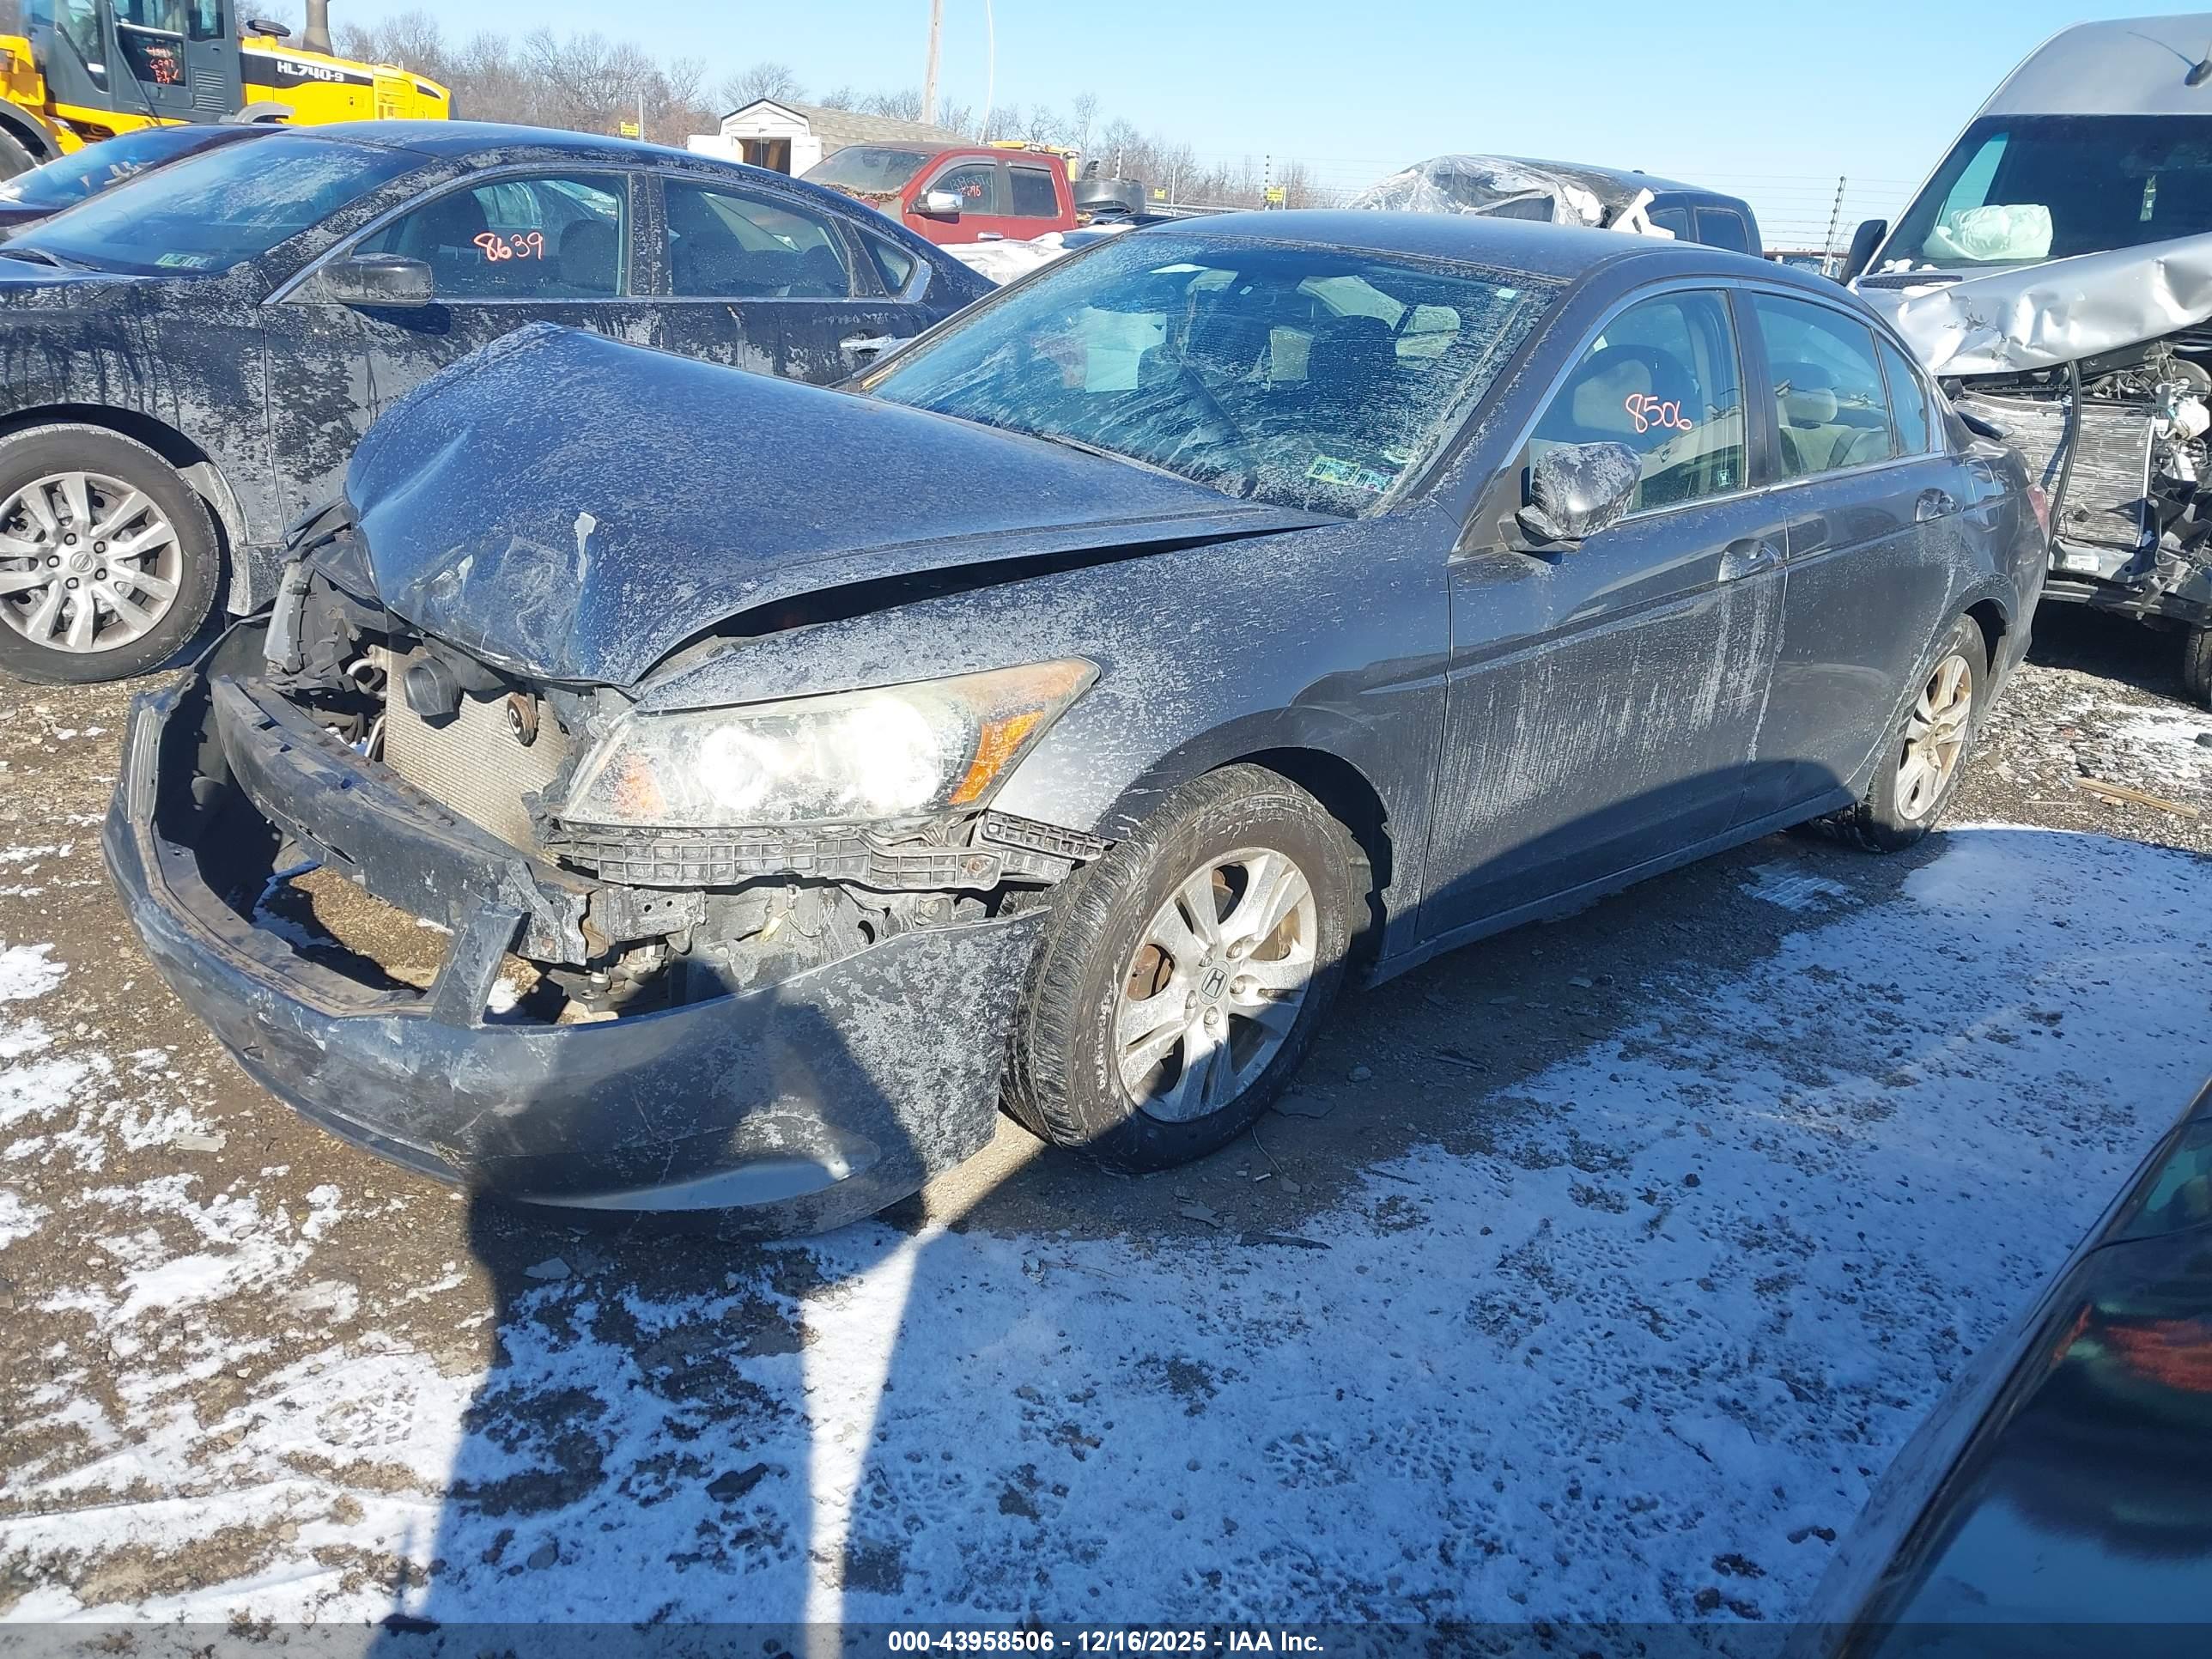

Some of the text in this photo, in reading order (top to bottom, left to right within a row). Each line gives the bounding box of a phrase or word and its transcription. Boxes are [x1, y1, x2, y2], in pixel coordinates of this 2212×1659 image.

[276, 60, 344, 83] HL740-9
[473, 231, 544, 262] 8639
[1625, 392, 1693, 434] 8506
